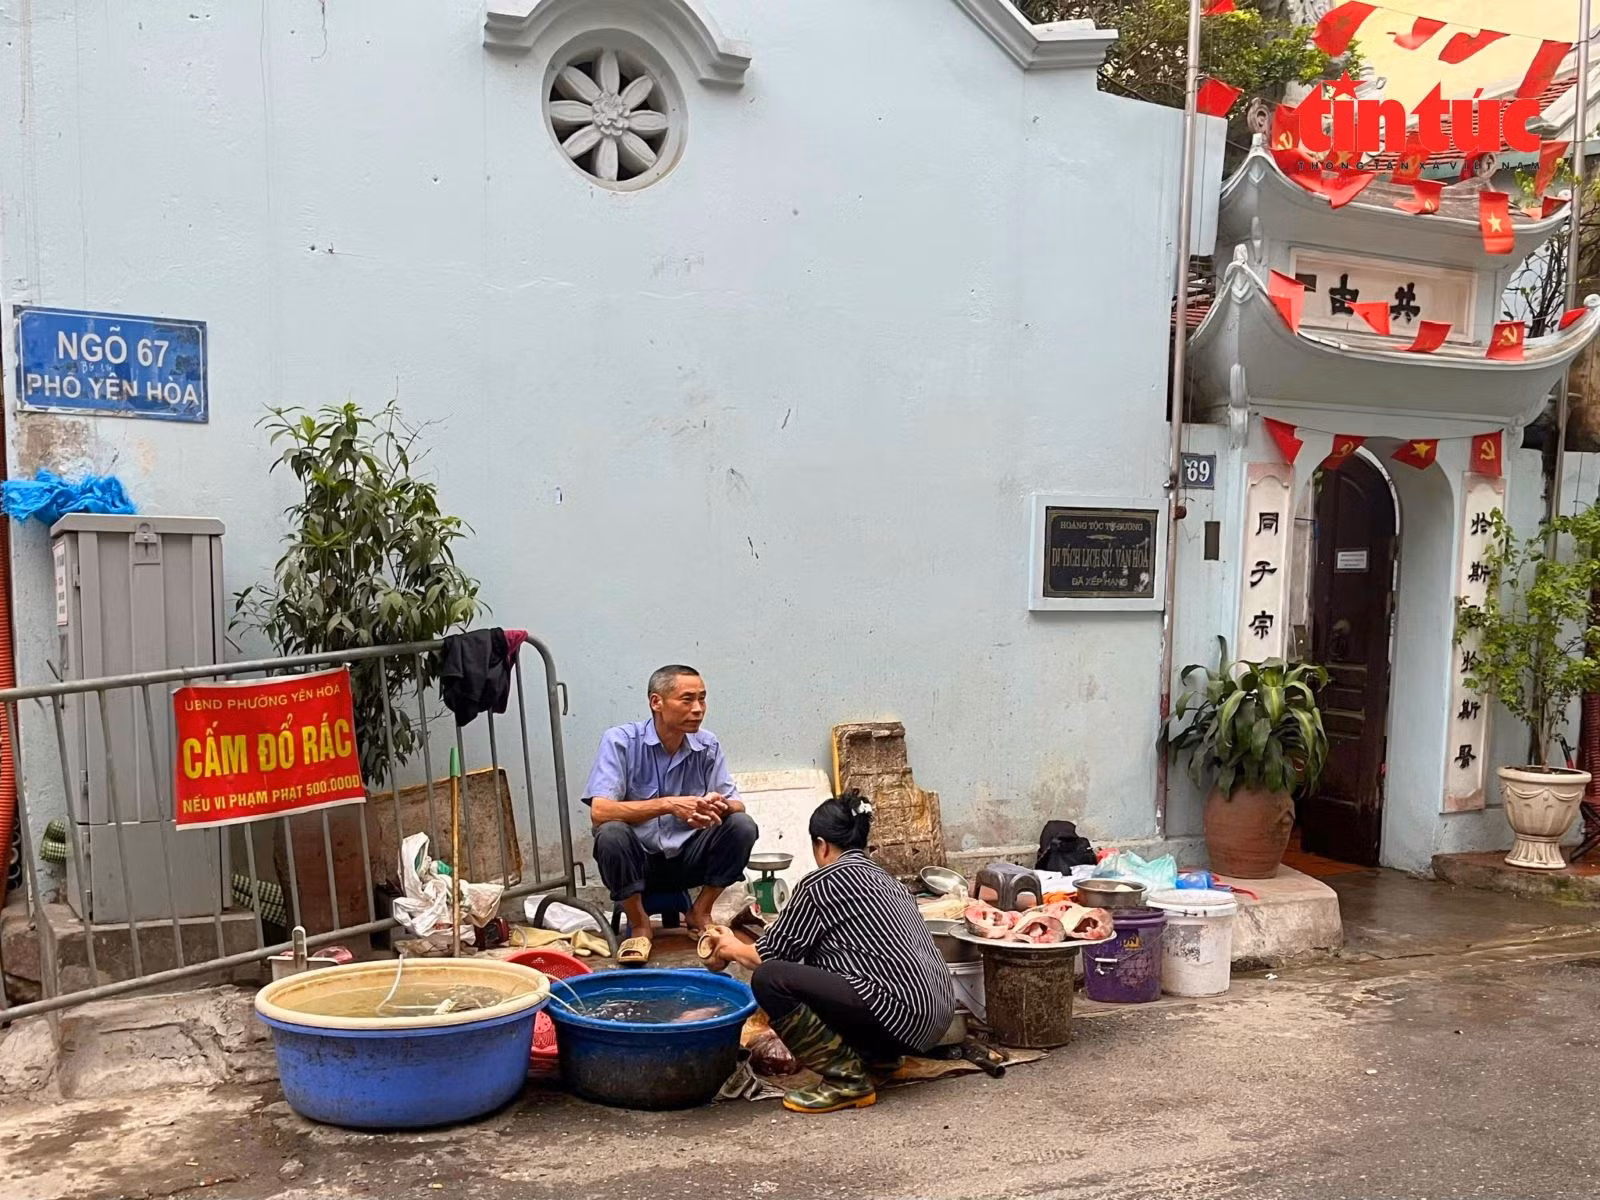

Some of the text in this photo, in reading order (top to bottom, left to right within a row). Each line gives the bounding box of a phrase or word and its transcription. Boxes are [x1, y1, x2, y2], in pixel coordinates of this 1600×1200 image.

[58, 326, 169, 368] NGÕ 67
[88, 372, 138, 400] YÊN
[147, 376, 200, 405] HÒA
[1187, 460, 1210, 482] 69
[184, 683, 341, 712] UBND PHƯỜNG YÊN HÒA
[183, 713, 352, 779] CẤM ĐỔ RÁC
[183, 794, 211, 814] NẾU
[214, 797, 226, 810] VI
[229, 790, 268, 809] PHẠM
[272, 785, 303, 803] PHẠT
